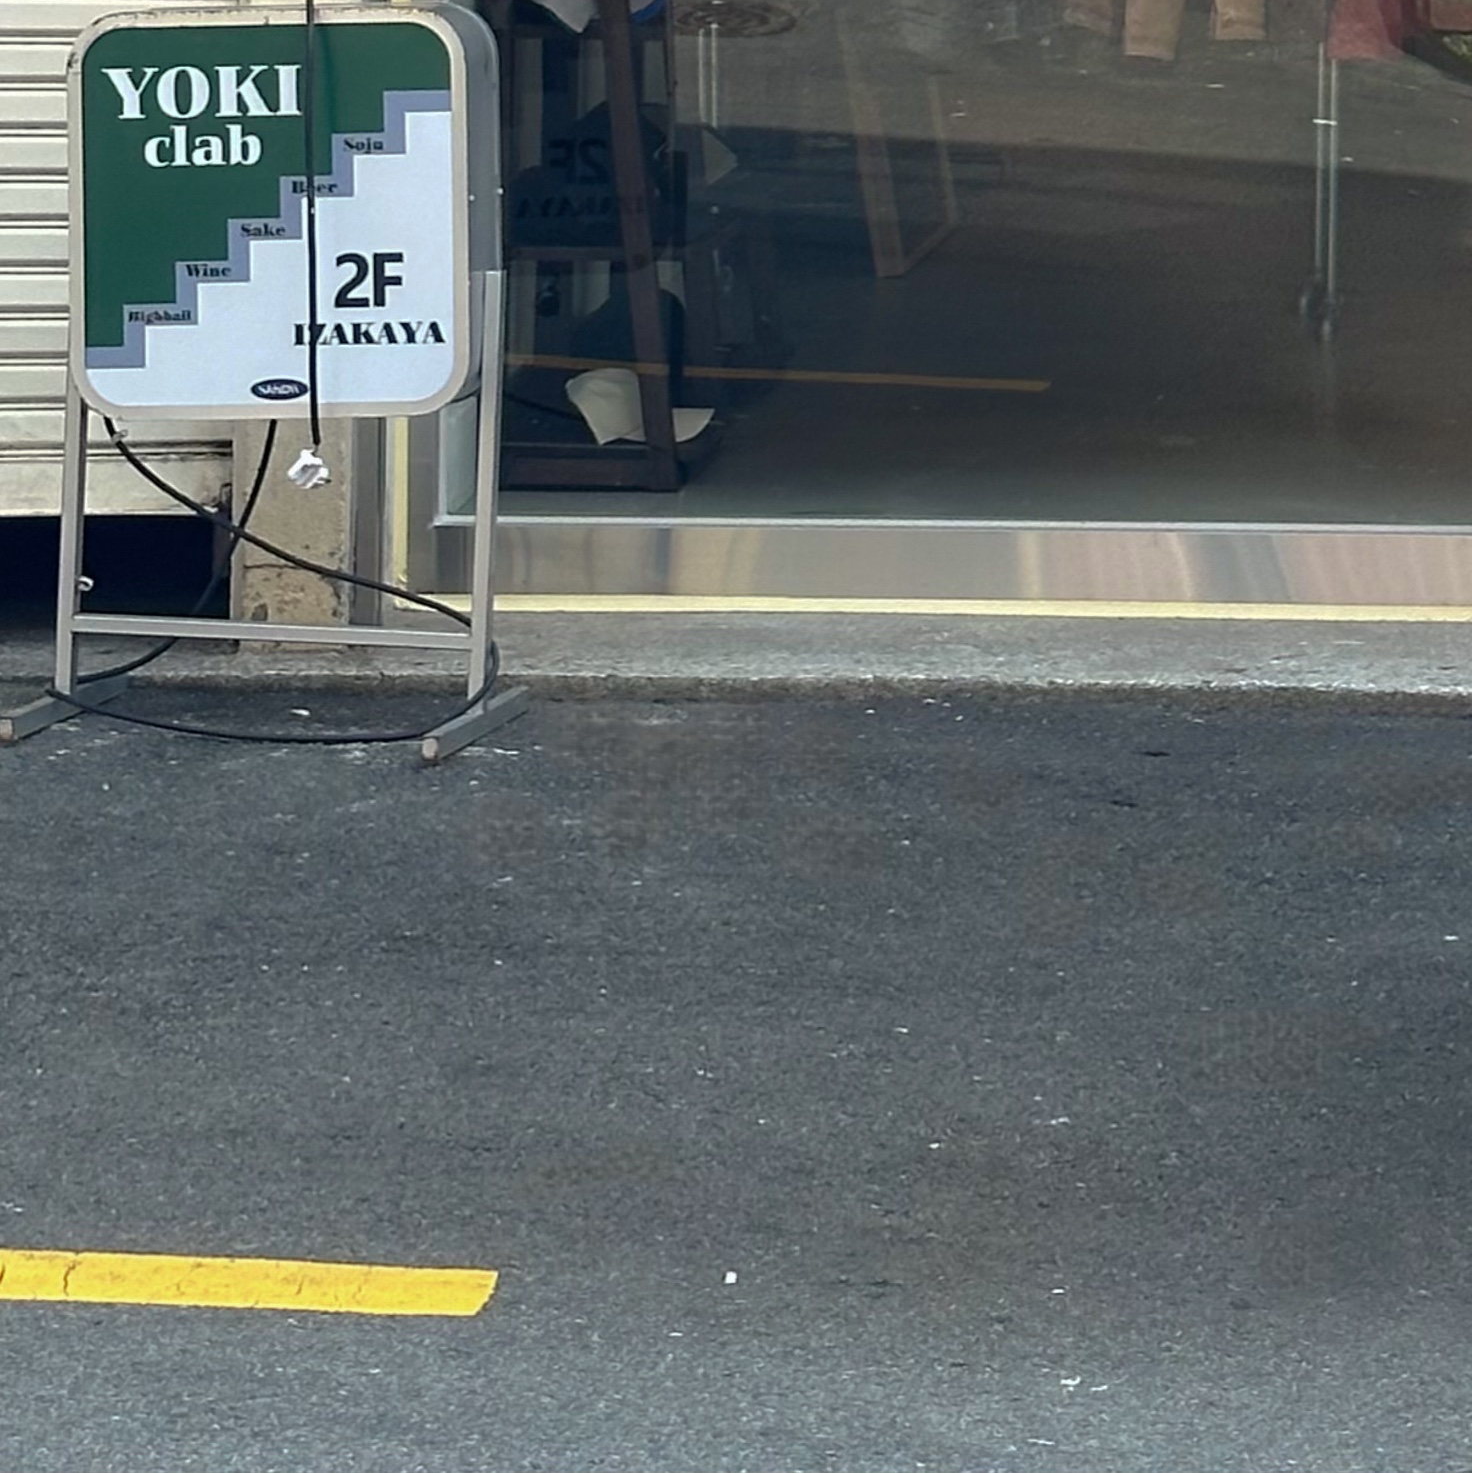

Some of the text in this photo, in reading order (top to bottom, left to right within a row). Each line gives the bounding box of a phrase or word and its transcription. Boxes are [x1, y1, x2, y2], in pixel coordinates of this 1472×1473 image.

[101, 65, 302, 119] YOKI
[144, 124, 263, 168] clab
[344, 138, 385, 153] Soju
[240, 223, 287, 237] Sake
[185, 264, 232, 278] Wine
[334, 252, 404, 308] 2F
